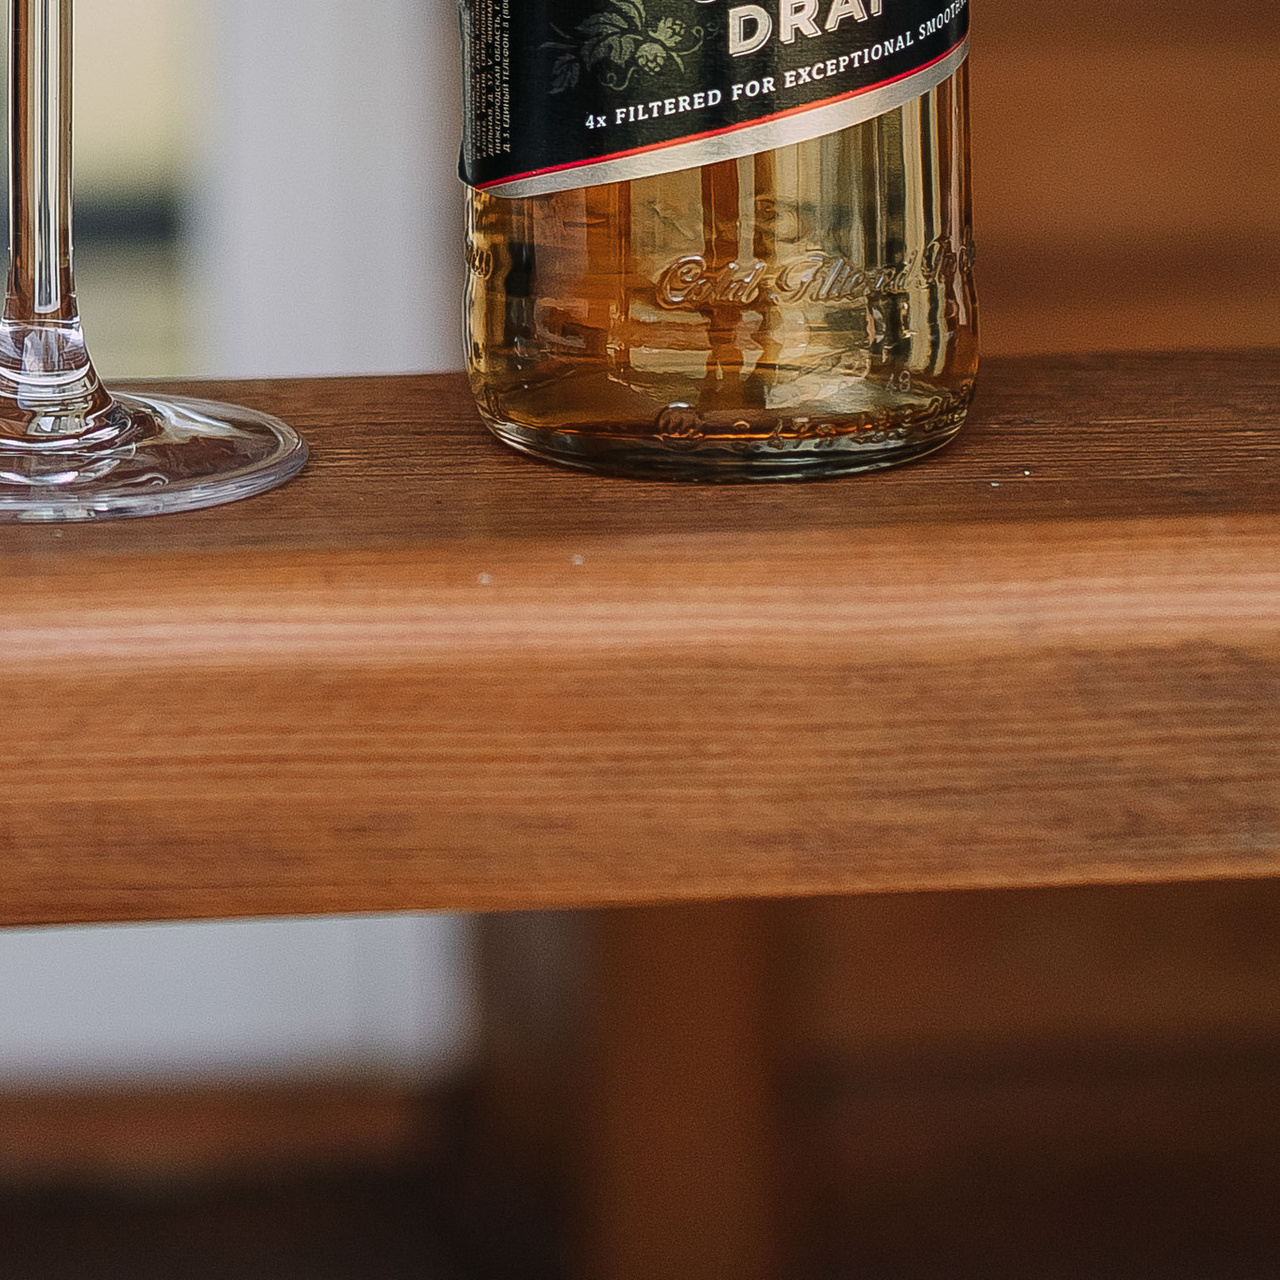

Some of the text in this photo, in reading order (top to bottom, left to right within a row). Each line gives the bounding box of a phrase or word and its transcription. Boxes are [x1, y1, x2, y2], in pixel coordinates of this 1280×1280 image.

[494, 14, 502, 62] ОБЛАСТЬ,
[502, 30, 510, 81] ТЕЛЕФОН:
[585, 114, 607, 130] 4x
[615, 89, 722, 125] FILTERED
[731, 76, 776, 102] FOR
[783, 30, 915, 89] EXCEPTIONAL
[502, 83, 511, 128] ЕДИНЫЙ
